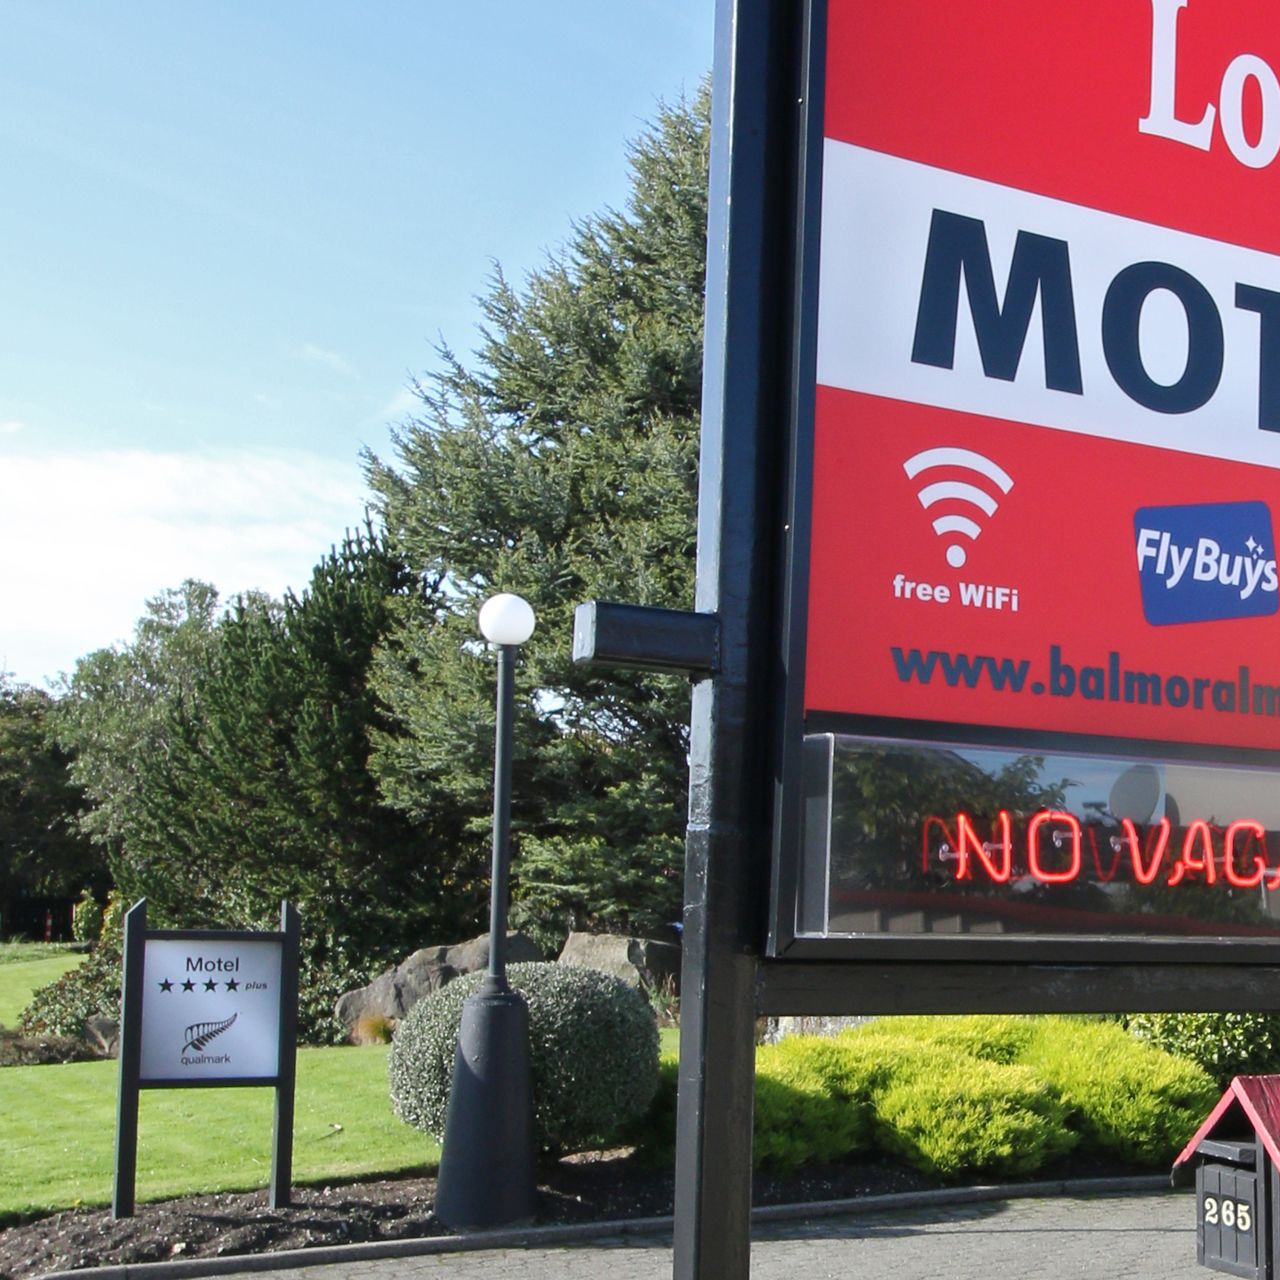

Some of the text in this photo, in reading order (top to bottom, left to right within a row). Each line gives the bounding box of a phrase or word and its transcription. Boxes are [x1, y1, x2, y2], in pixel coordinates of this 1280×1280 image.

[893, 574, 1018, 611] free WiFi
[955, 809, 1082, 884] NO
[186, 957, 240, 972] Motel
[245, 981, 268, 990] plus
[181, 1054, 231, 1065] qualmark
[1204, 1197, 1251, 1231] 265
